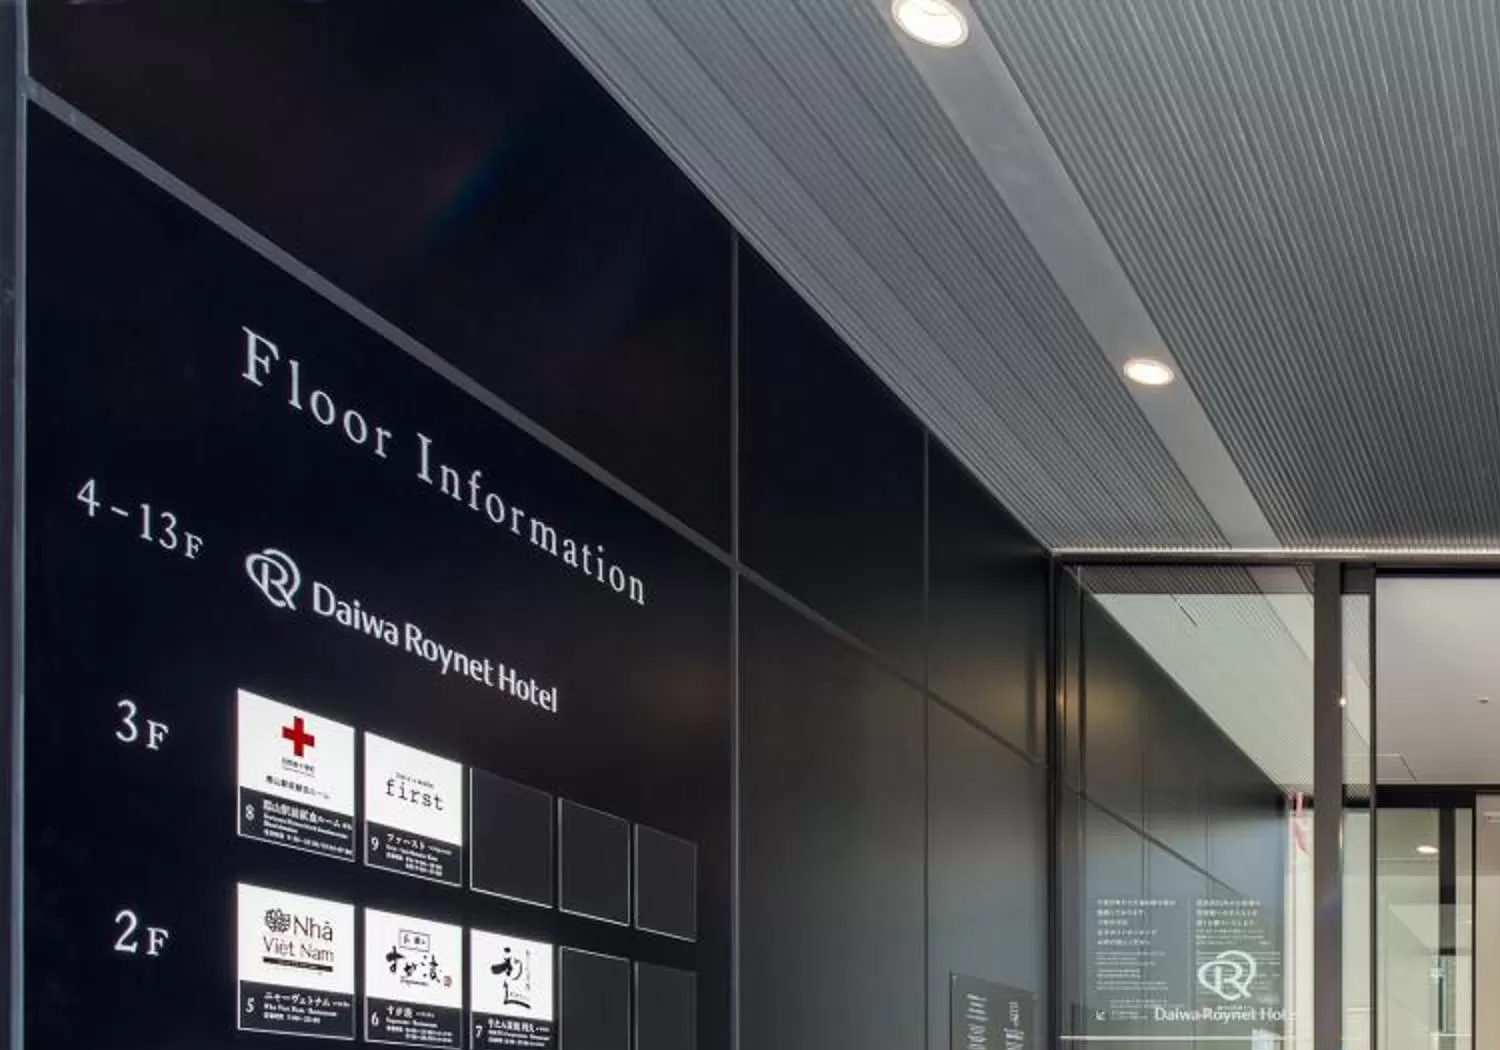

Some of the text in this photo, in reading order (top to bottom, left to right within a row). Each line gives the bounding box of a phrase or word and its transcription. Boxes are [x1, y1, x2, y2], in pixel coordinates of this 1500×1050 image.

[241, 326, 645, 605] Floor Information
[313, 581, 558, 713] Daiwa Roynet Hotel
[115, 700, 169, 750] 3F
[385, 778, 444, 811] first
[245, 804, 255, 821] 8
[371, 836, 379, 851] 9
[114, 910, 169, 956] 2F
[301, 943, 334, 962] Nam
[245, 997, 255, 1014] 5
[371, 1011, 380, 1027] 6
[1154, 1007, 1199, 1022] Daiwa
[1202, 1007, 1255, 1025] Roynet
[475, 1025, 483, 1038] 7
